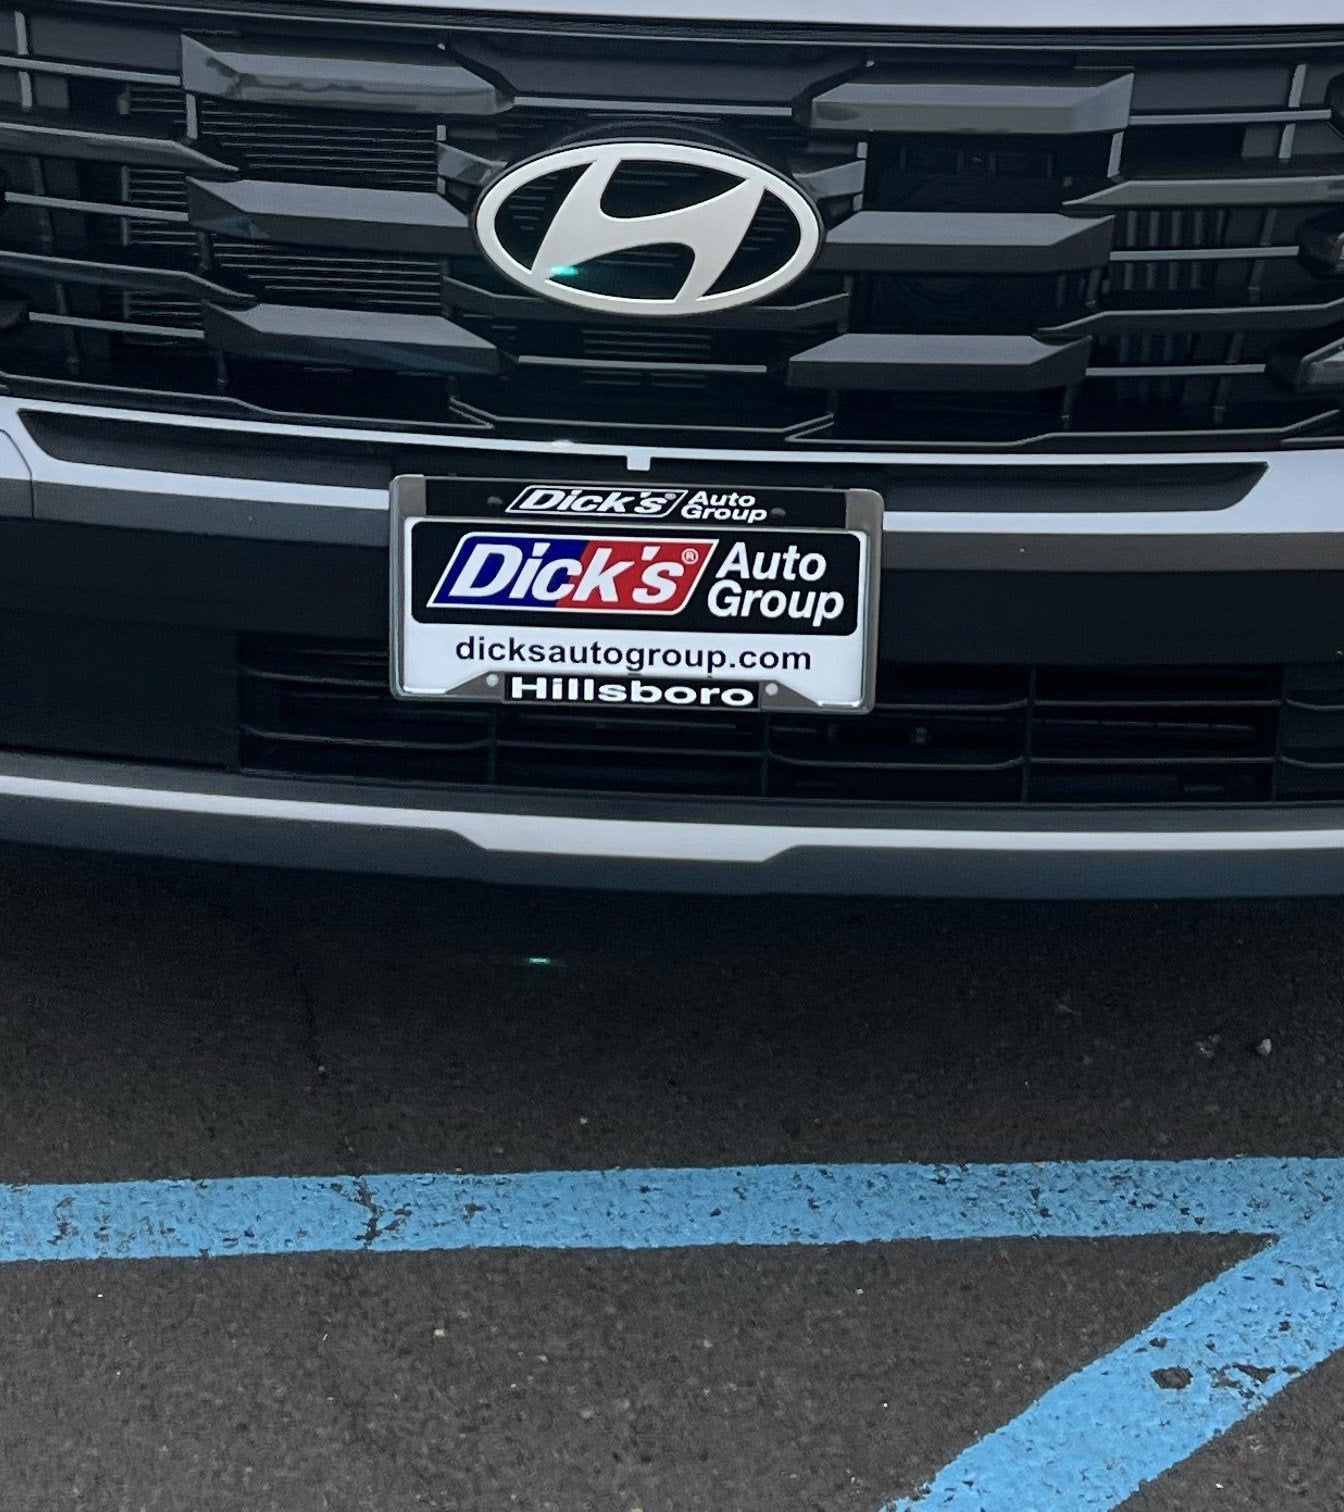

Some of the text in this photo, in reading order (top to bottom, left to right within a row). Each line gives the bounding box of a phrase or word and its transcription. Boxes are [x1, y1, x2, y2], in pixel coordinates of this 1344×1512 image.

[518, 488, 669, 515] Dick's
[680, 504, 768, 524] Group
[687, 490, 756, 507] Auto
[448, 541, 686, 605] Dick's
[715, 541, 828, 581] Auto
[707, 579, 845, 627] Group
[455, 636, 811, 676] dicksautogroup.com
[511, 676, 755, 707] Hillsboro
